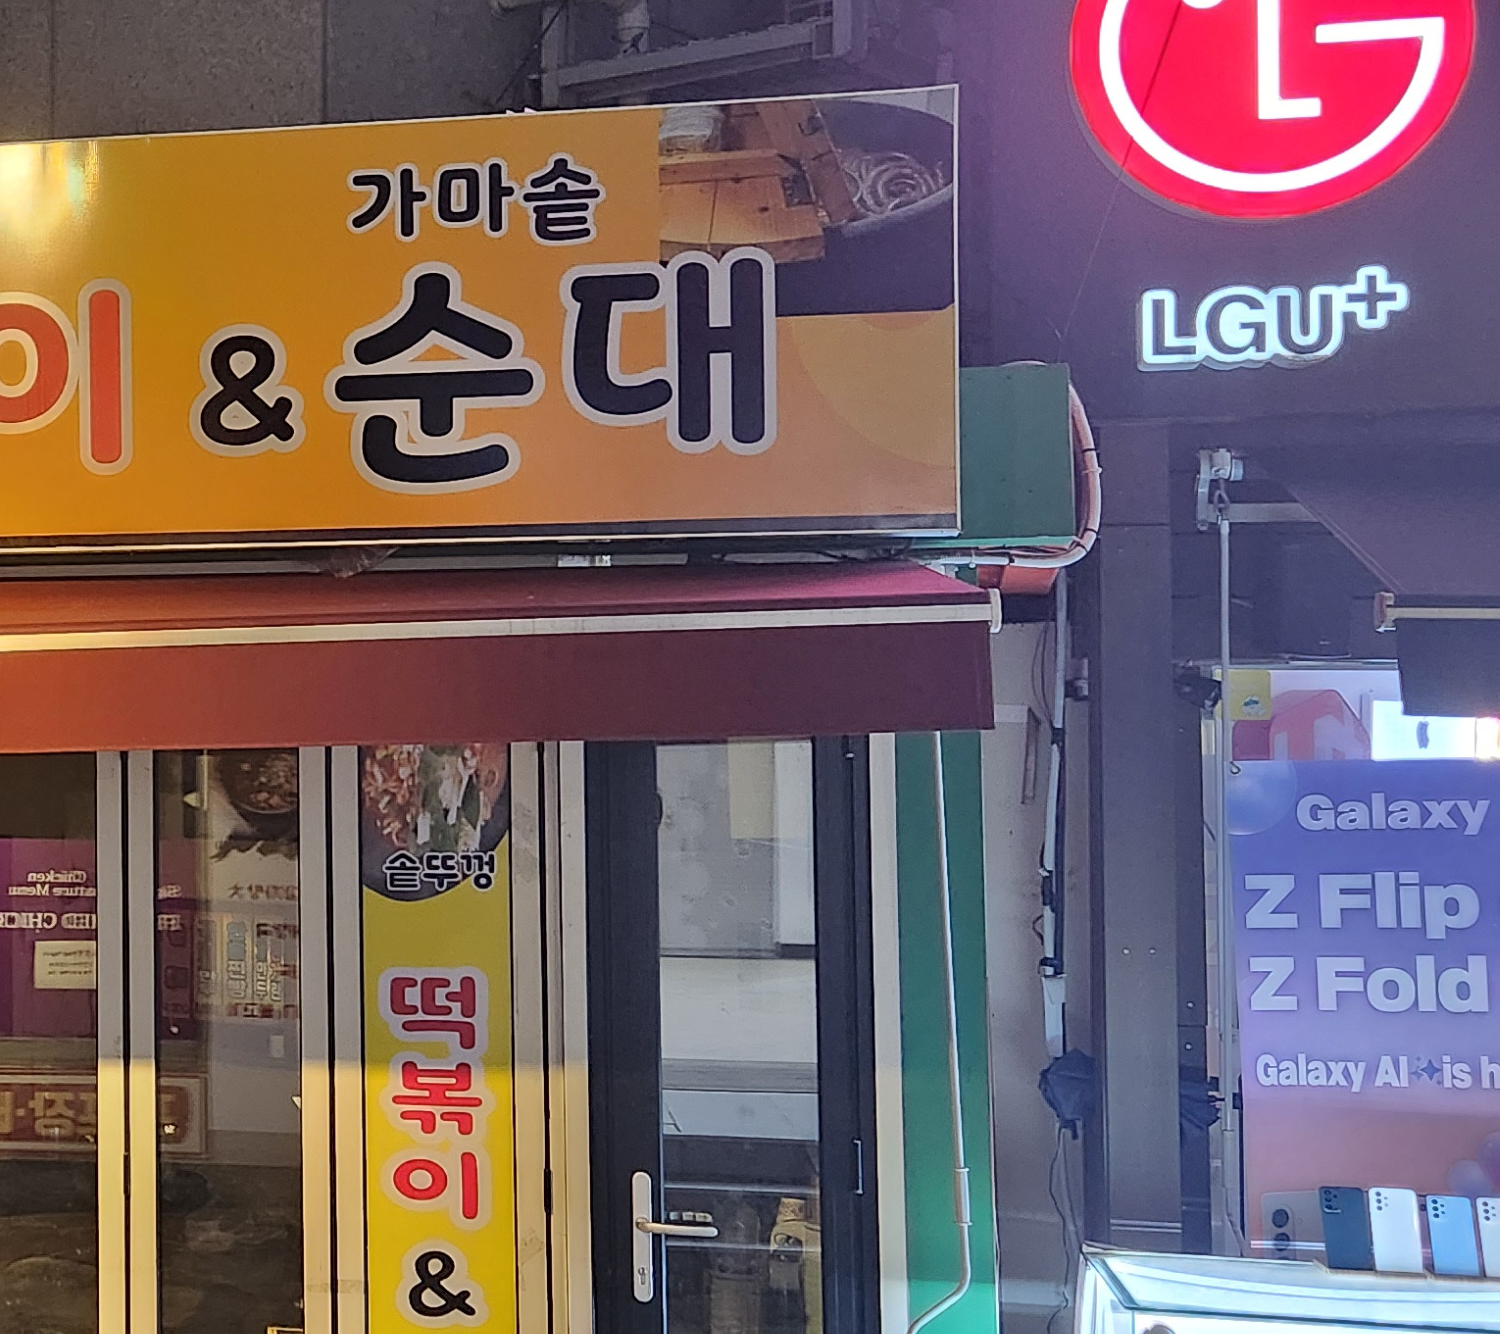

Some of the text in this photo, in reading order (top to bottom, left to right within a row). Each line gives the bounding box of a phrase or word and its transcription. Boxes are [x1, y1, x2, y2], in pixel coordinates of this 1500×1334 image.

[350, 155, 604, 244] 가마솥
[1146, 270, 1402, 361] LGU+
[197, 332, 300, 448] &
[333, 254, 766, 487] 순대
[1296, 791, 1491, 836] Galaxy
[384, 851, 496, 891] 솥뚜껑
[1243, 871, 1481, 940] Z Flip
[1249, 955, 1489, 1014] Z Fold
[389, 974, 483, 1220] 떡볶이
[1256, 1052, 1366, 1093] Galaxy
[1374, 1055, 1409, 1088] AI
[1442, 1054, 1473, 1089] is
[407, 1249, 477, 1318] &
